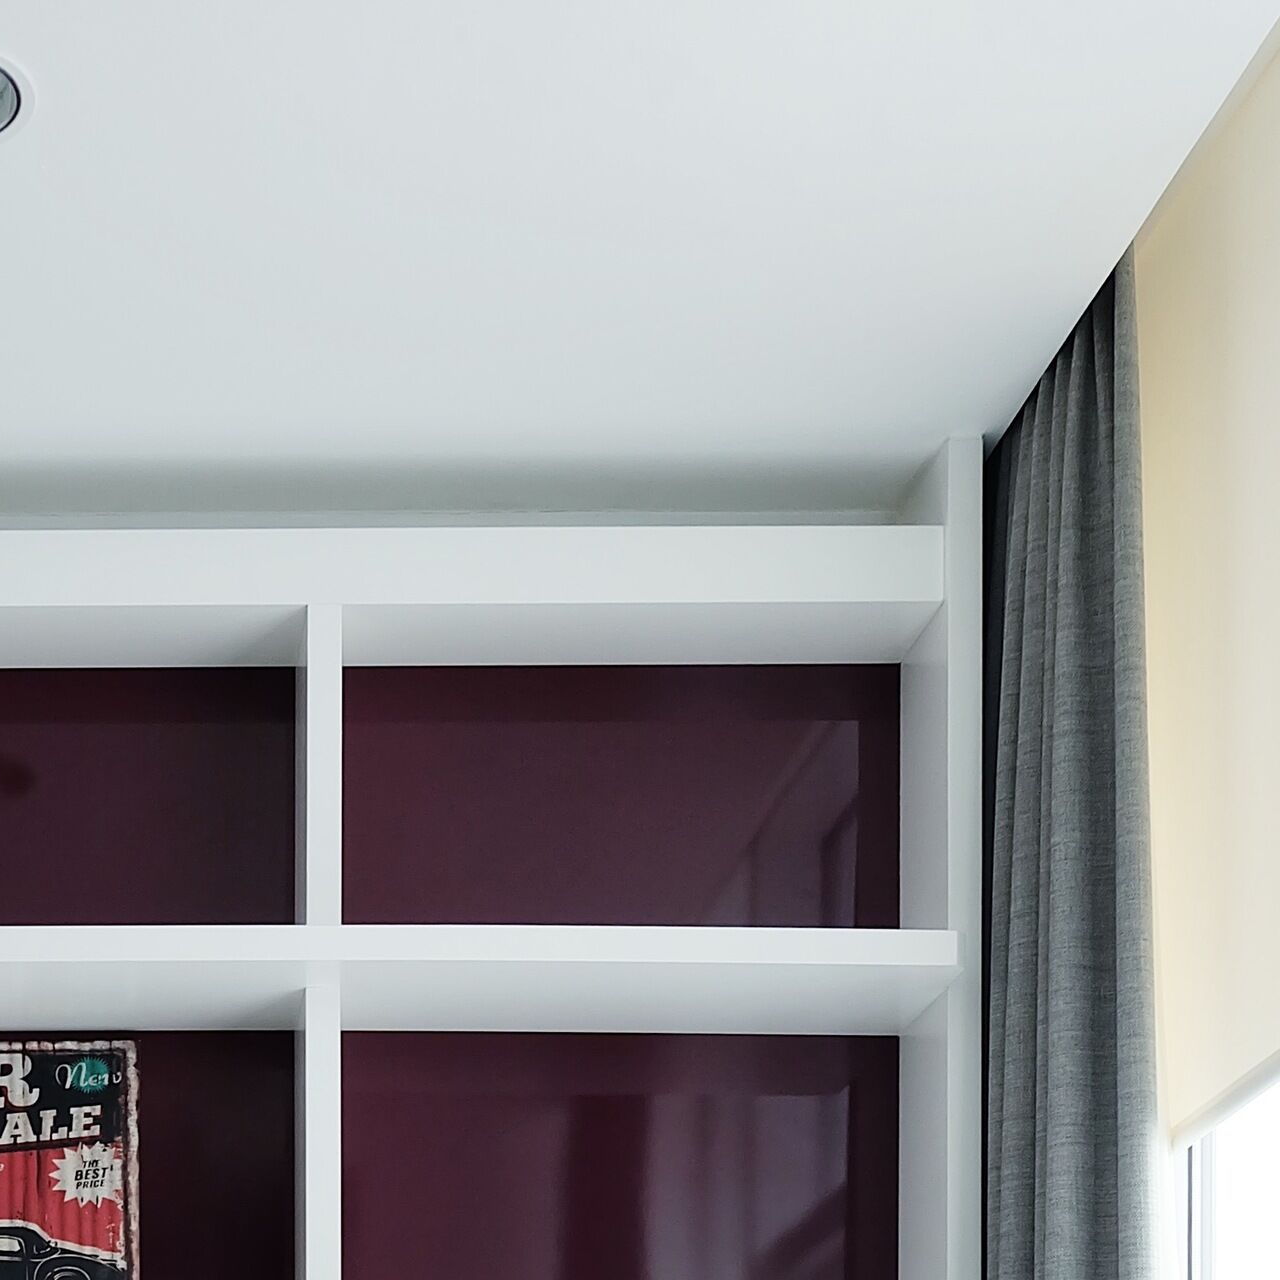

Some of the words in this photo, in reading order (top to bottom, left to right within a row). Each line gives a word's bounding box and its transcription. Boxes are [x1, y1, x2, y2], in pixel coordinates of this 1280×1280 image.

[55, 1062, 122, 1090] New
[82, 1160, 100, 1169] THE
[74, 1167, 109, 1182] BEST
[75, 1179, 105, 1190] PRICE
